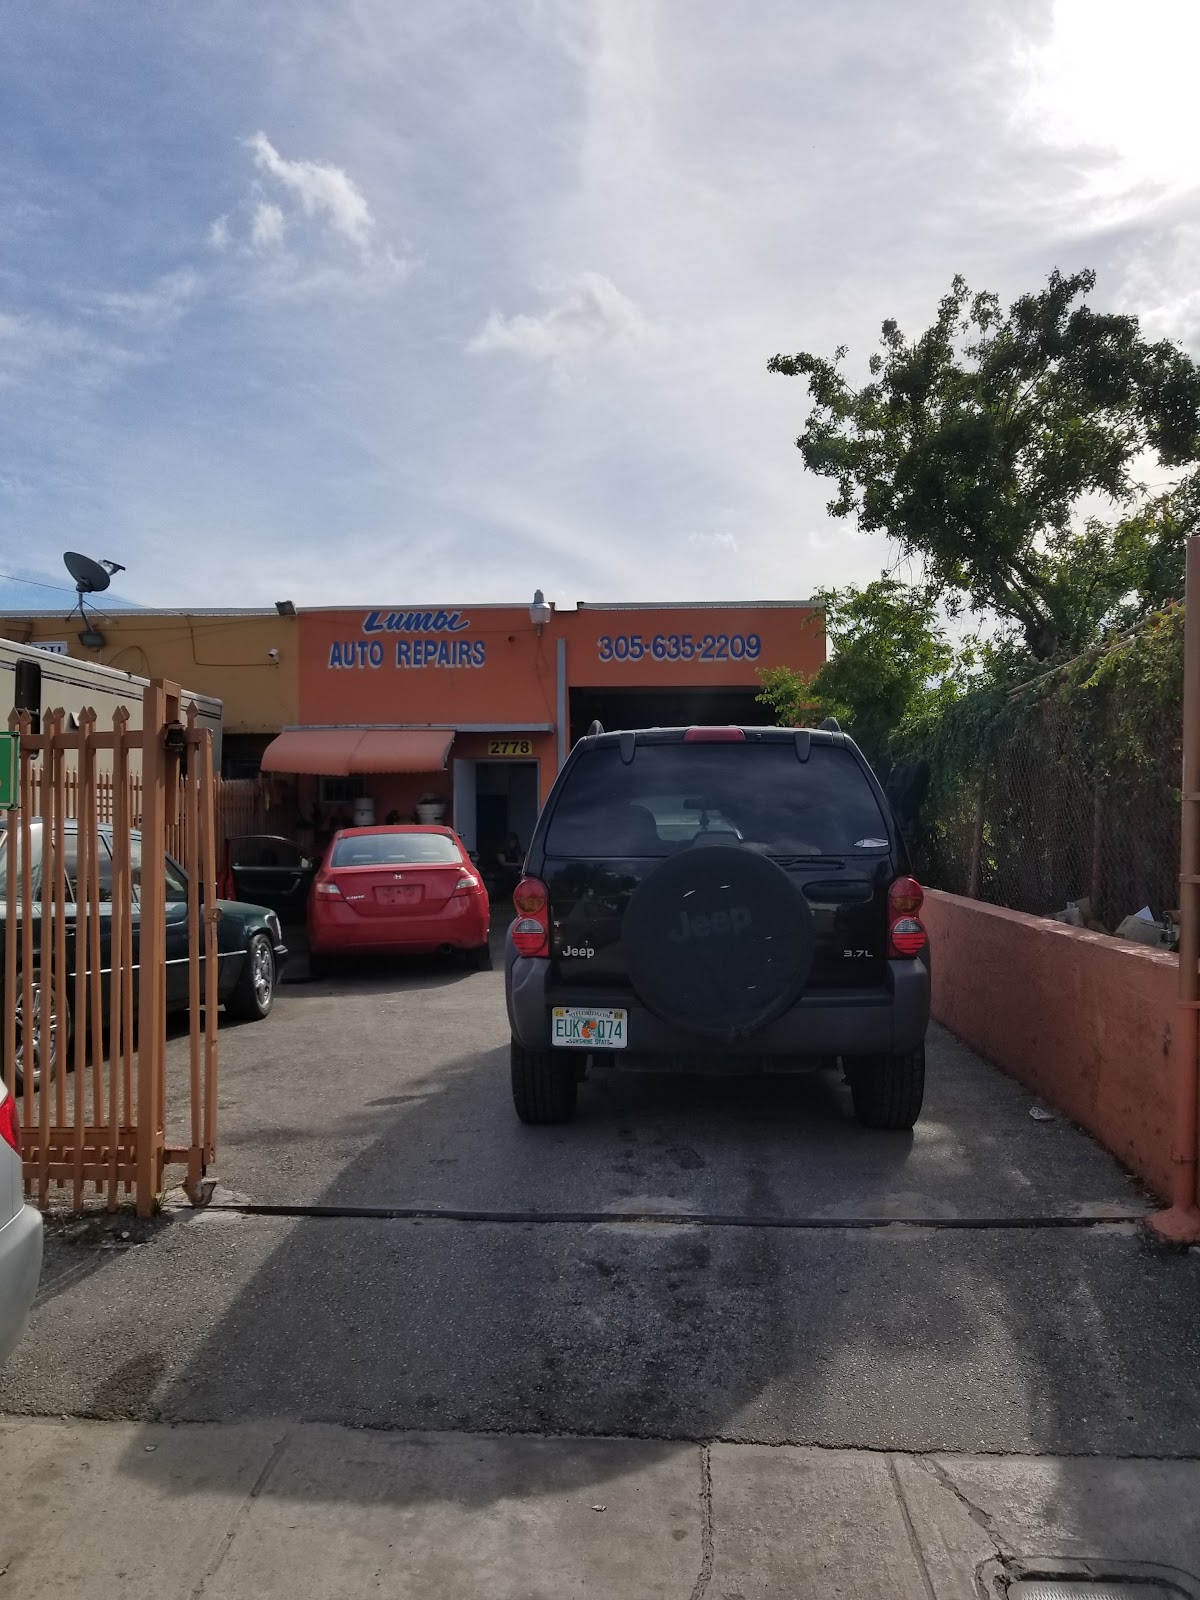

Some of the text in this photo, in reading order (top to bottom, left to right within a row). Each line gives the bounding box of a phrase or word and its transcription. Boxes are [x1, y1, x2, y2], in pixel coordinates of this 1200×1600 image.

[362, 610, 470, 634] Lumbi
[328, 640, 486, 669] AUTO REPAIRS
[490, 741, 530, 754] 2778
[667, 906, 752, 942] Jeep
[562, 945, 595, 959] Jeep
[556, 1019, 581, 1038] EUK
